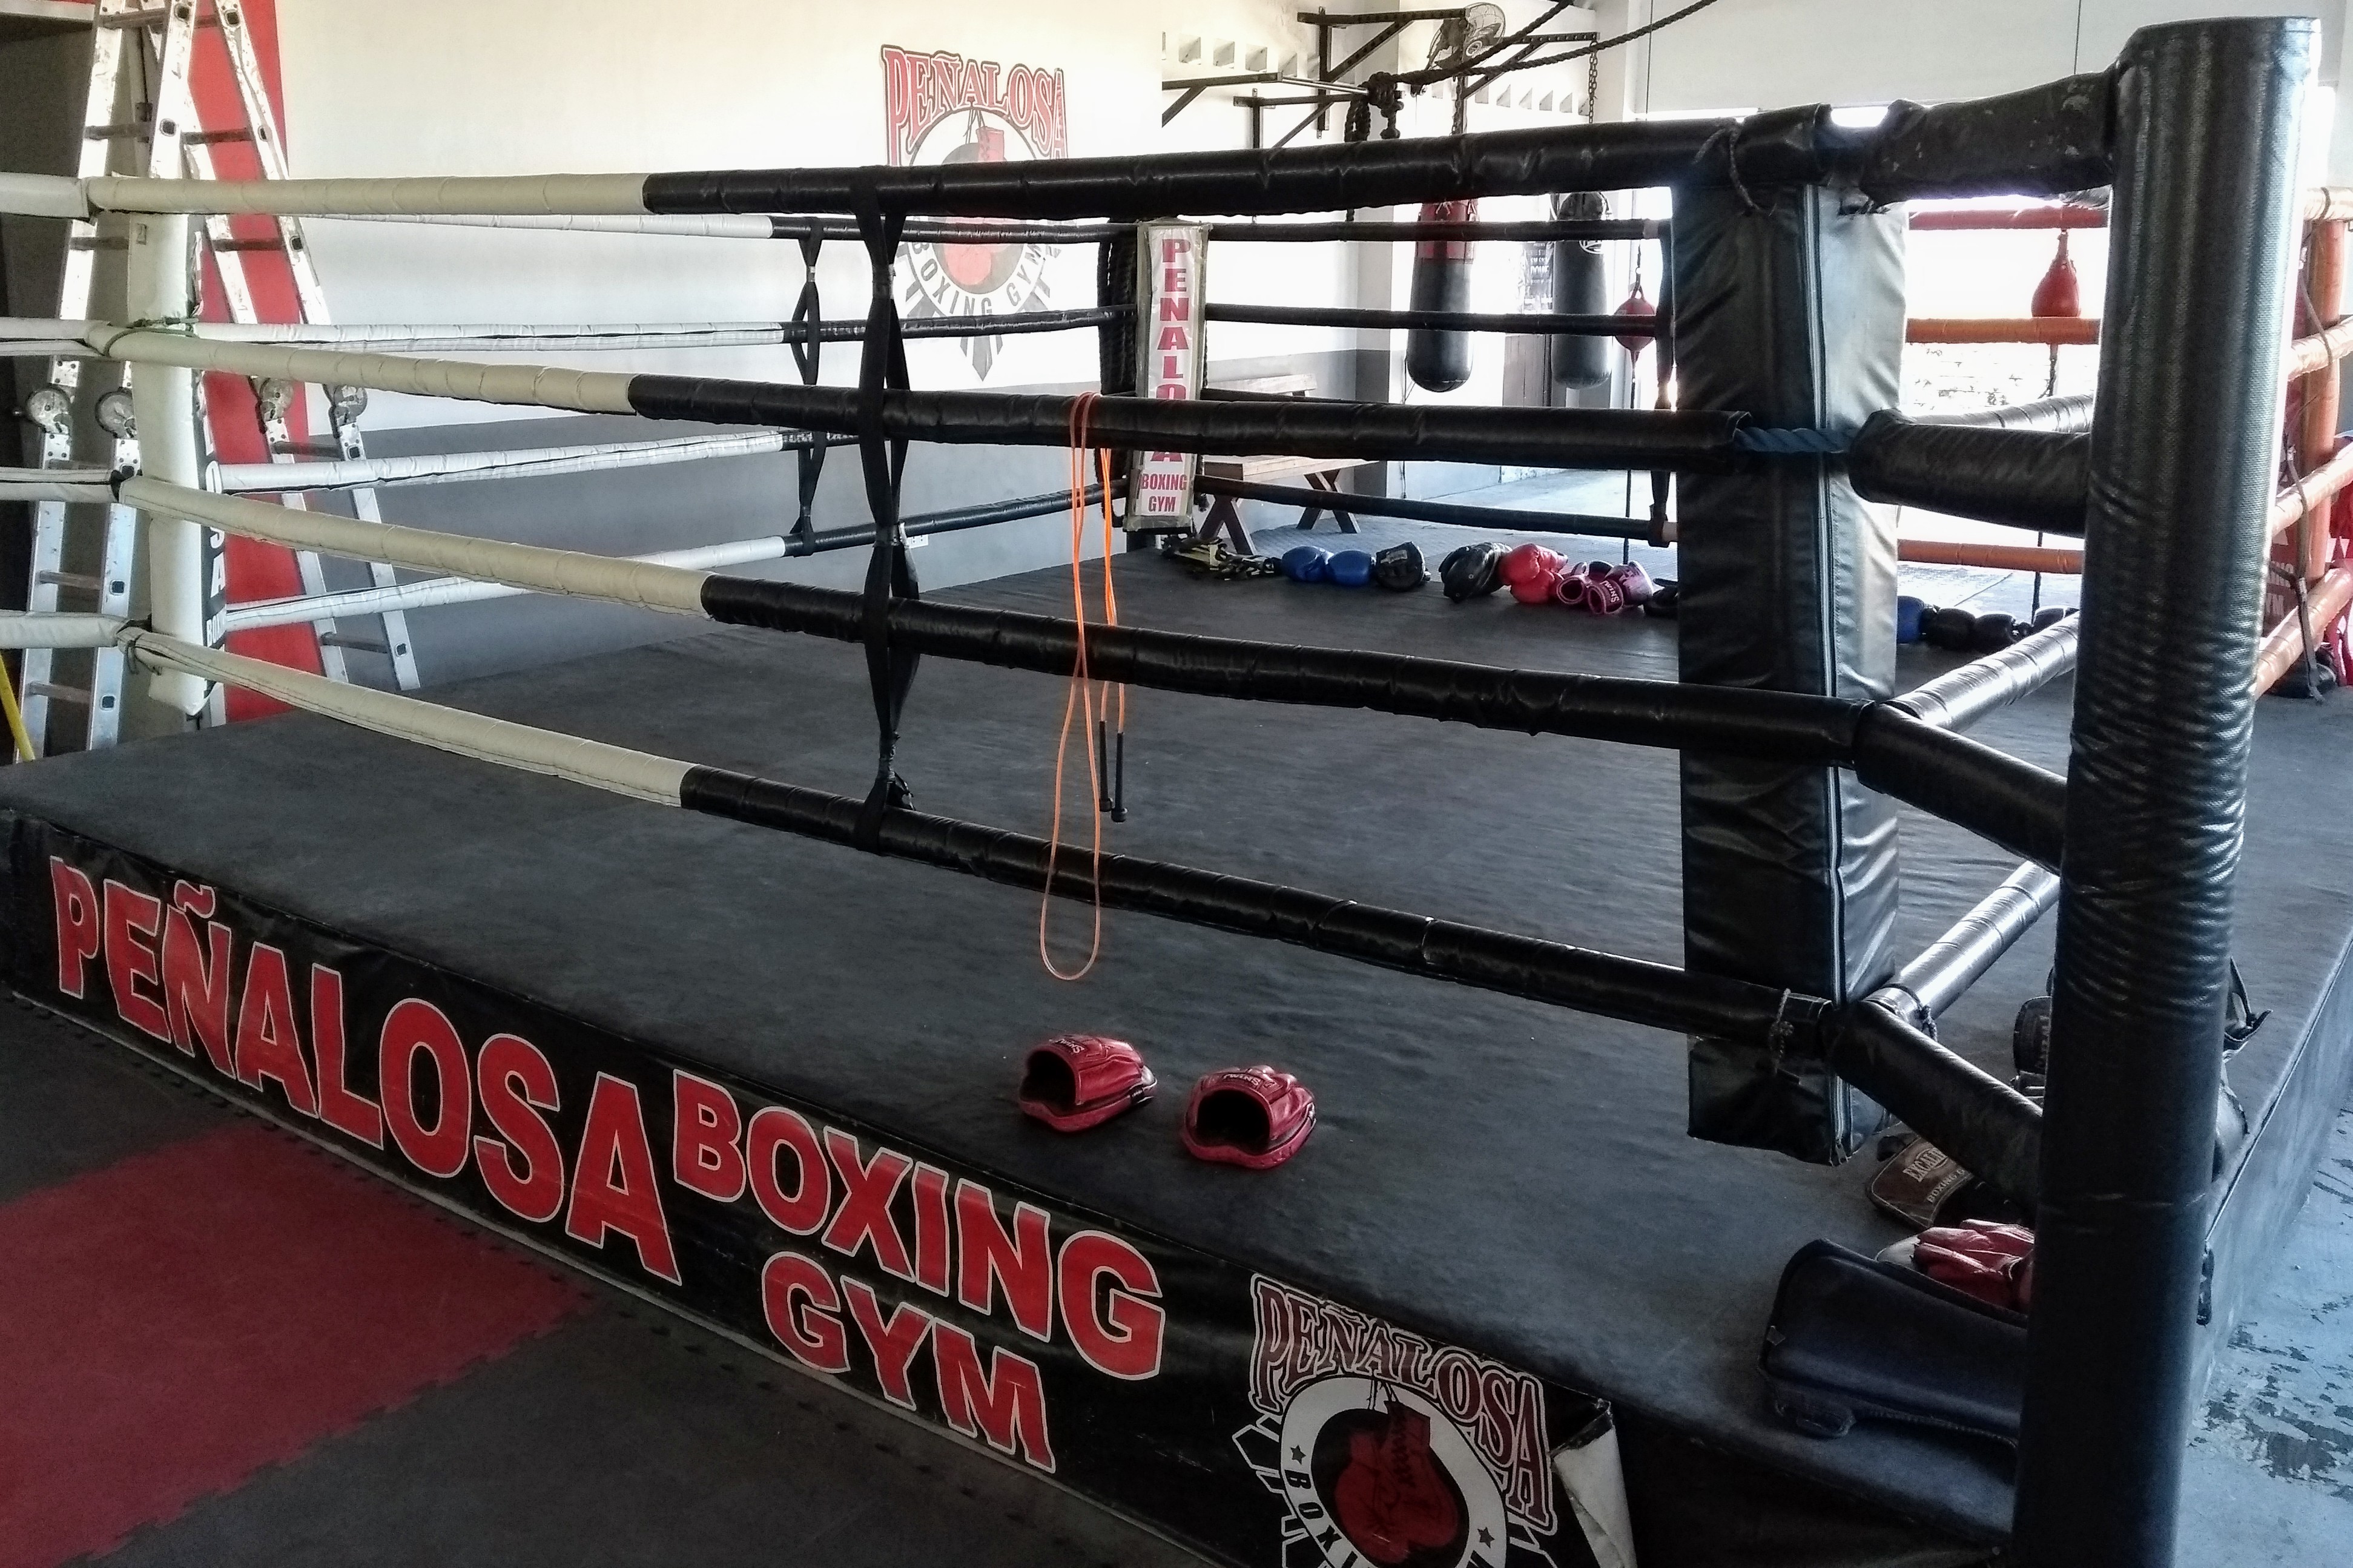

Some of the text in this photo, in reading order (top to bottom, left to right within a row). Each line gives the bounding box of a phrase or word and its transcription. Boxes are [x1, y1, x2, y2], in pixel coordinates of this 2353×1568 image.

[911, 242, 1042, 316] BOXING GYM
[1141, 473, 1187, 491] BOXING
[1148, 496, 1176, 513] GYM
[1600, 580, 1620, 603] TWINS
[50, 855, 1166, 1380] PEÑALOSA BOXING
[1927, 1174, 1958, 1204] BOXING
[761, 1251, 1056, 1474] GYM
